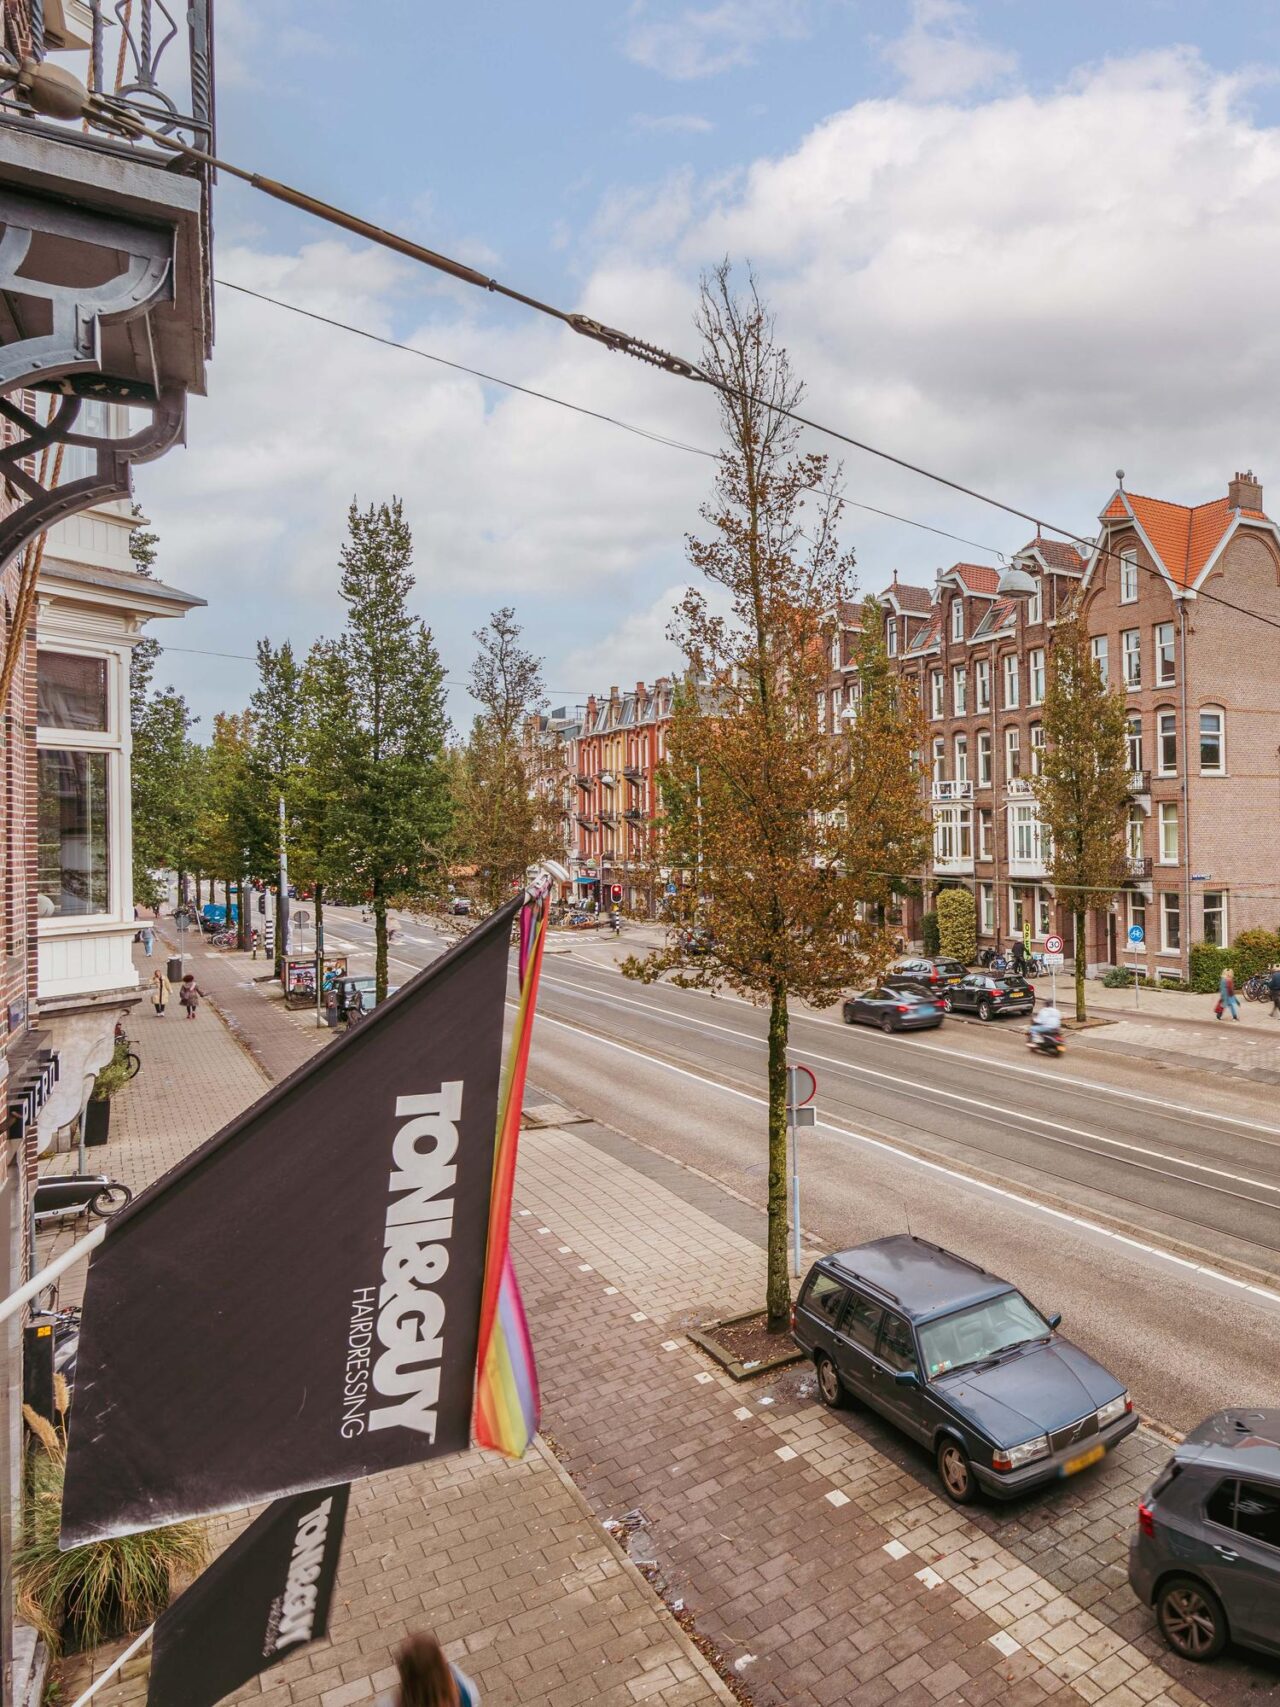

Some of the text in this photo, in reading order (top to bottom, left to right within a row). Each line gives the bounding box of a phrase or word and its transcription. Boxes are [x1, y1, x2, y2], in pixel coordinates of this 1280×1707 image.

[1048, 940, 1060, 949] 30
[368, 1080, 464, 1445] TONI&GUY
[340, 1286, 377, 1439] HAIRDRESSING
